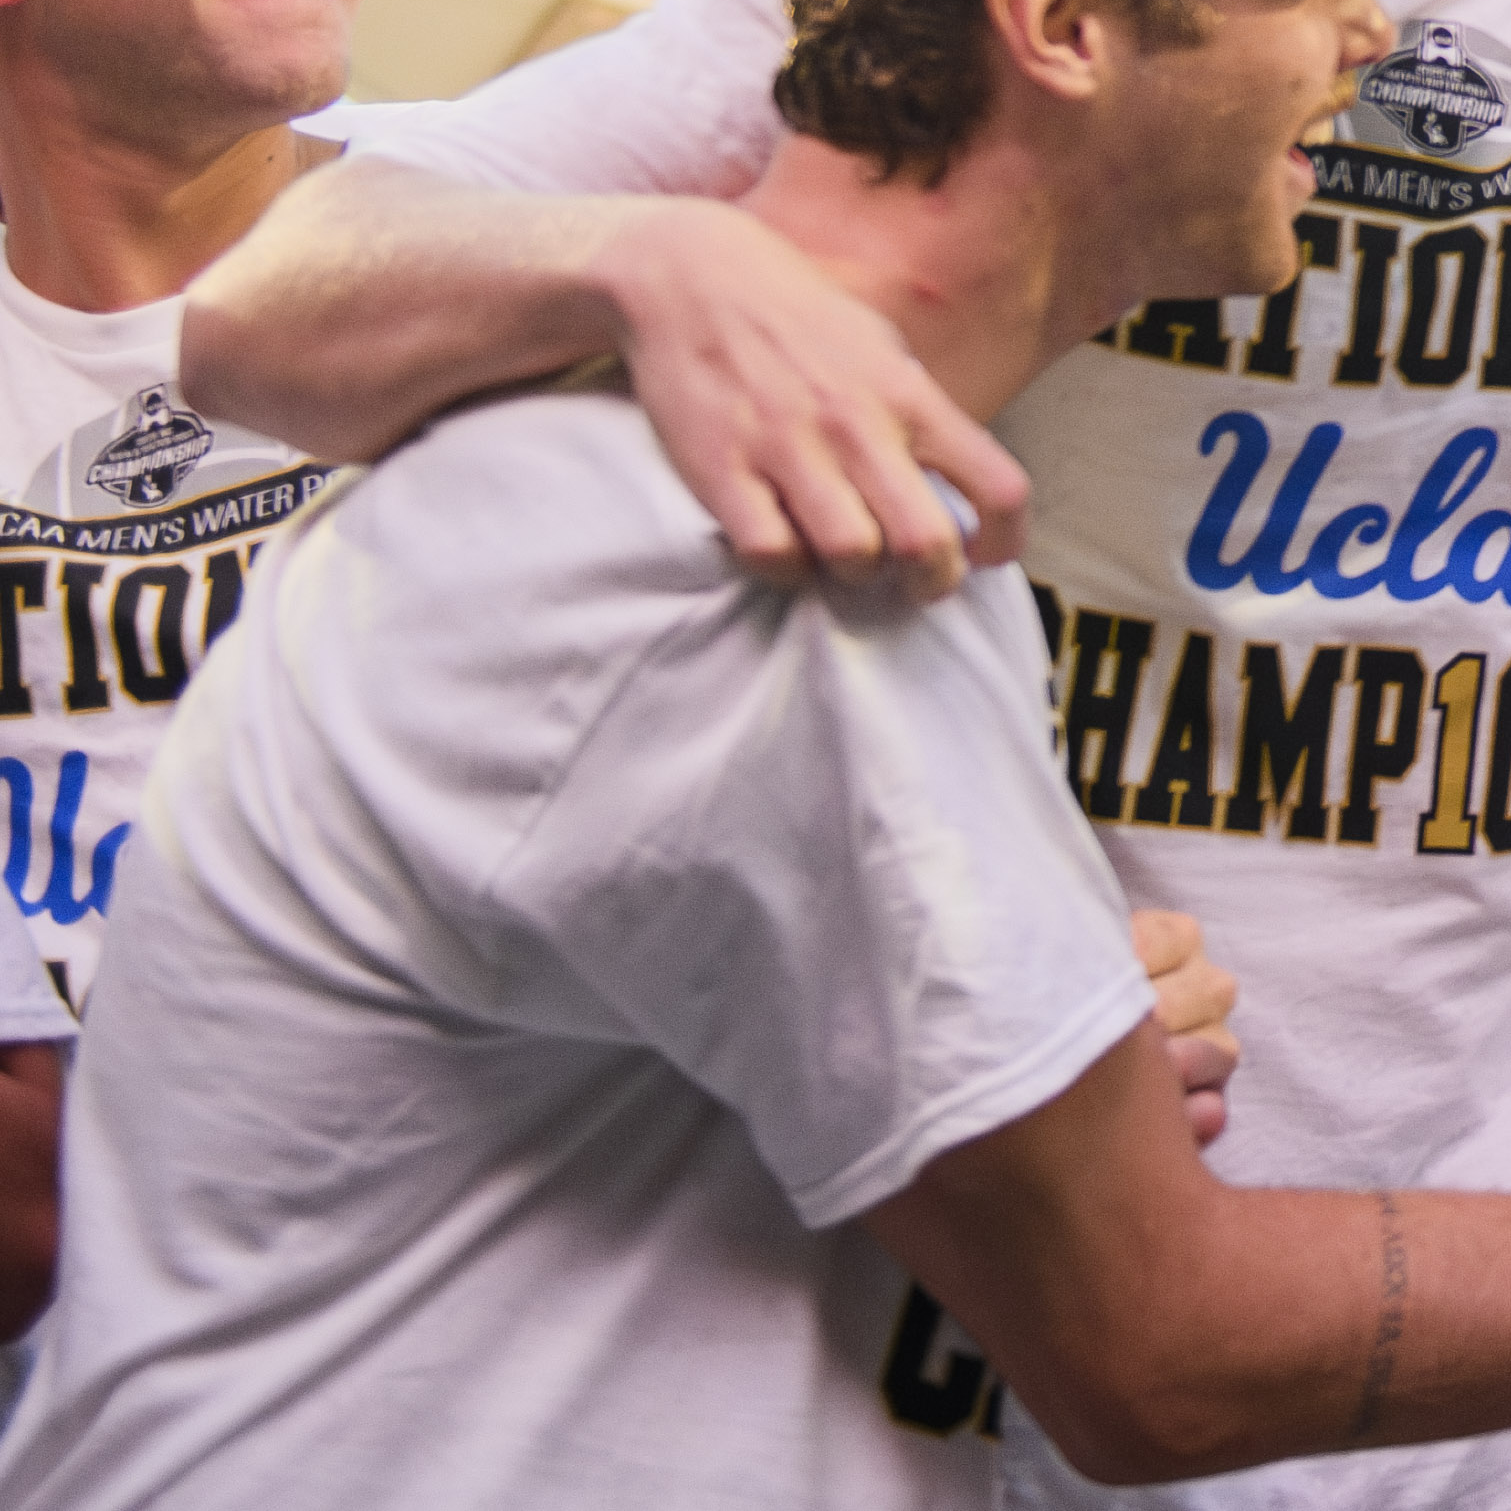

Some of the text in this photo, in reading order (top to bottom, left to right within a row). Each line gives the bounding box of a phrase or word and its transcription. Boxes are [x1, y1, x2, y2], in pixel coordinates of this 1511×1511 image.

[1363, 163, 1474, 211] MEN'S
[0, 512, 66, 544] CAA
[75, 516, 187, 552] MEN'S
[191, 482, 296, 537] WATER
